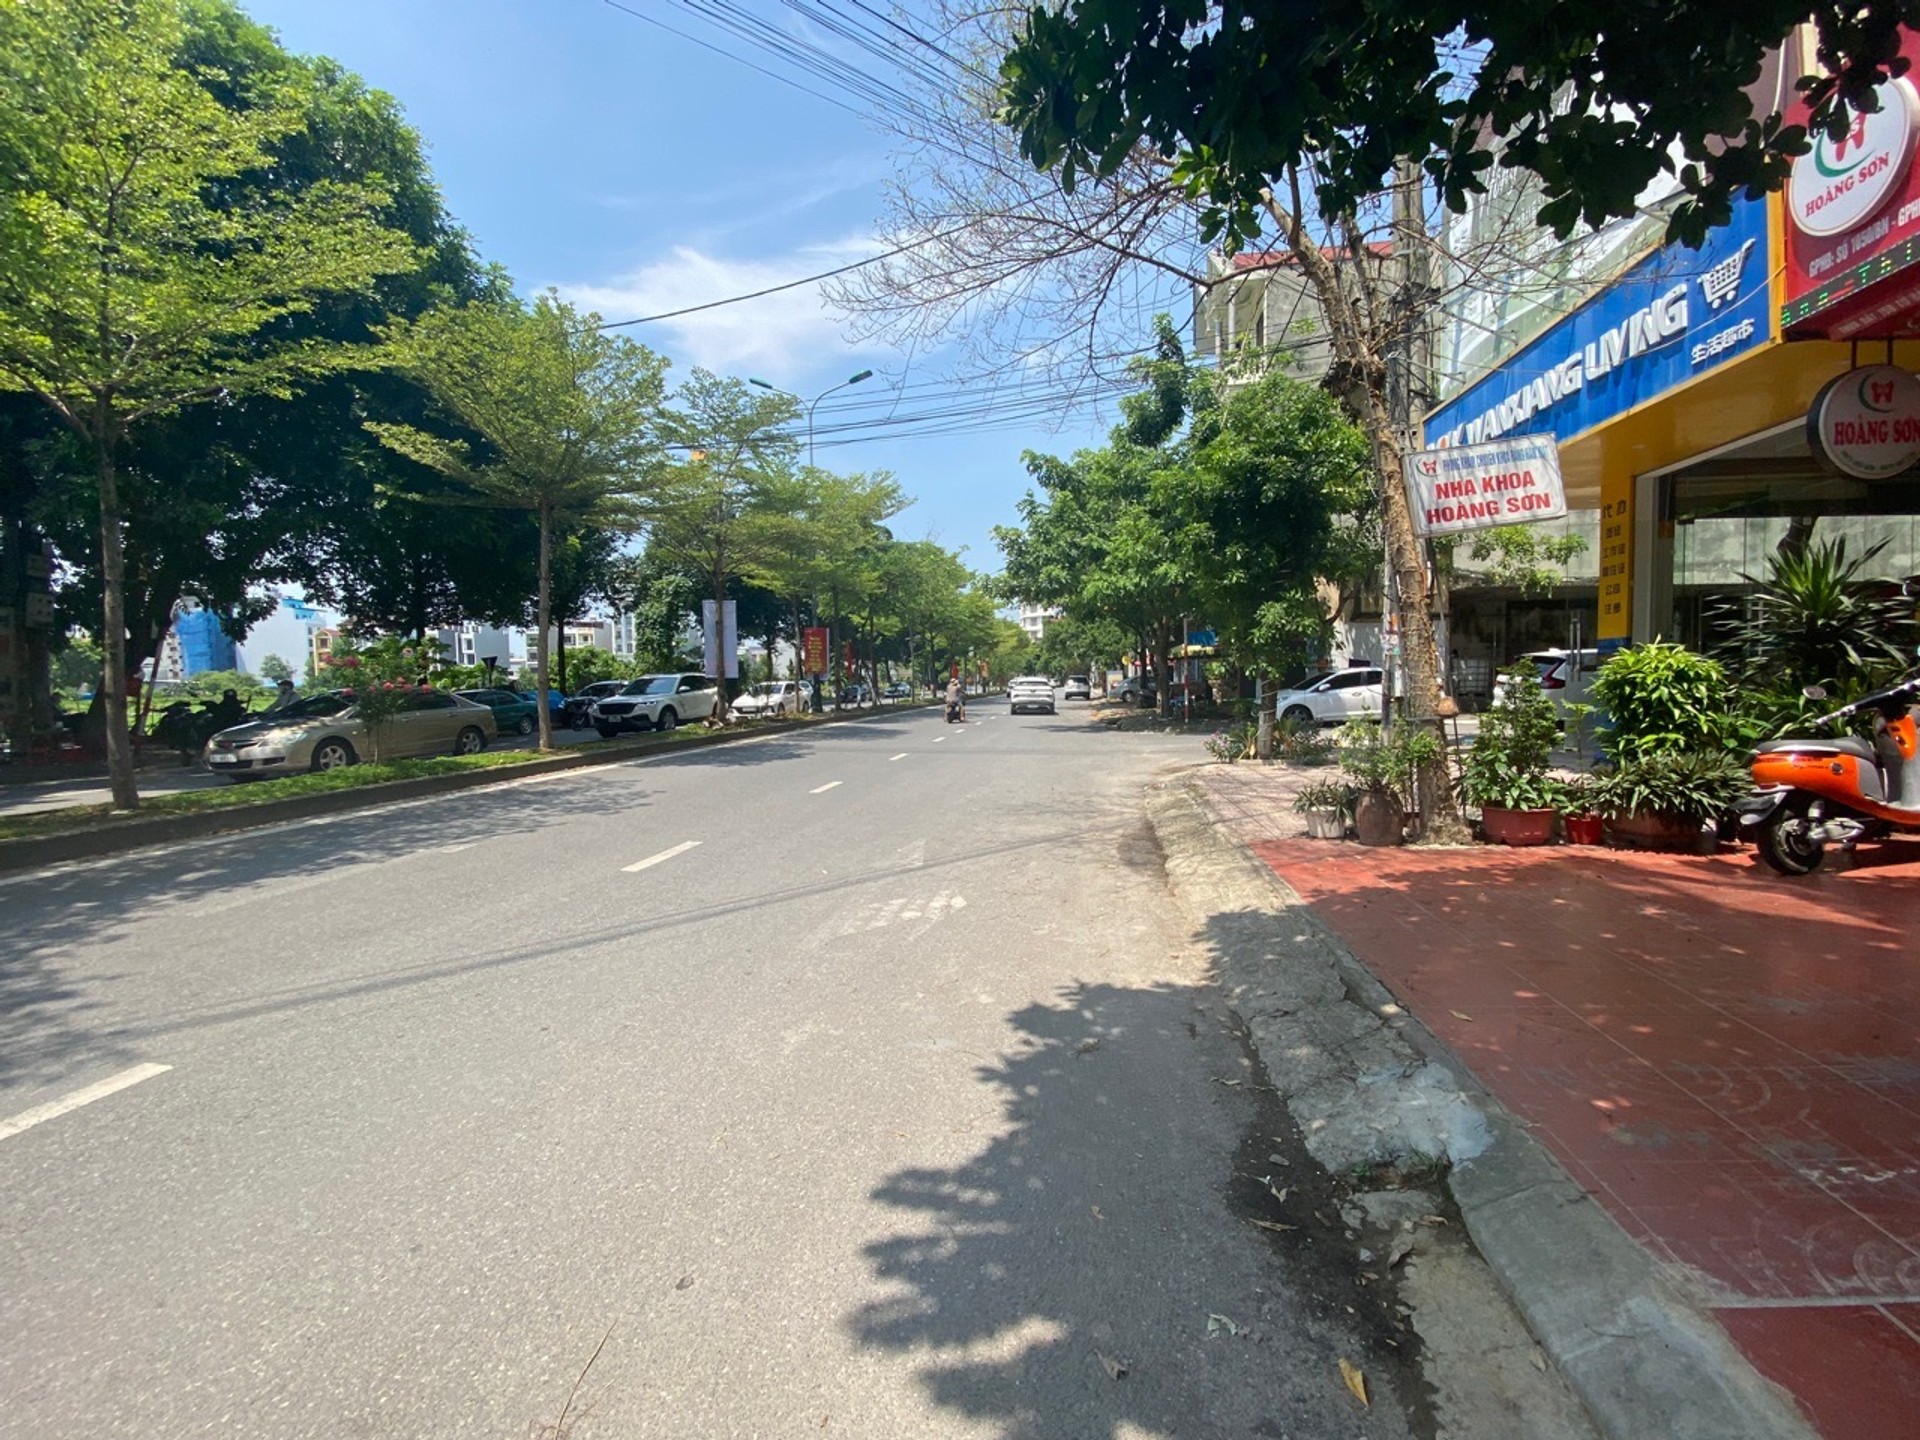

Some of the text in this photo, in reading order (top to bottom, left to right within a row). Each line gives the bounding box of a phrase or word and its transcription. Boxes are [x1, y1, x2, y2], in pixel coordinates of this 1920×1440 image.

[1805, 152, 1891, 217] HOÀNG SƠN
[1691, 318, 1755, 366] 生活超市
[1466, 350, 1583, 446] WANXIANG
[1585, 283, 1688, 382] LIVING
[1834, 412, 1889, 446] HOÀNG
[1435, 470, 1536, 500] NHA KHOA
[1426, 492, 1552, 525] HOÀNG SƠN
